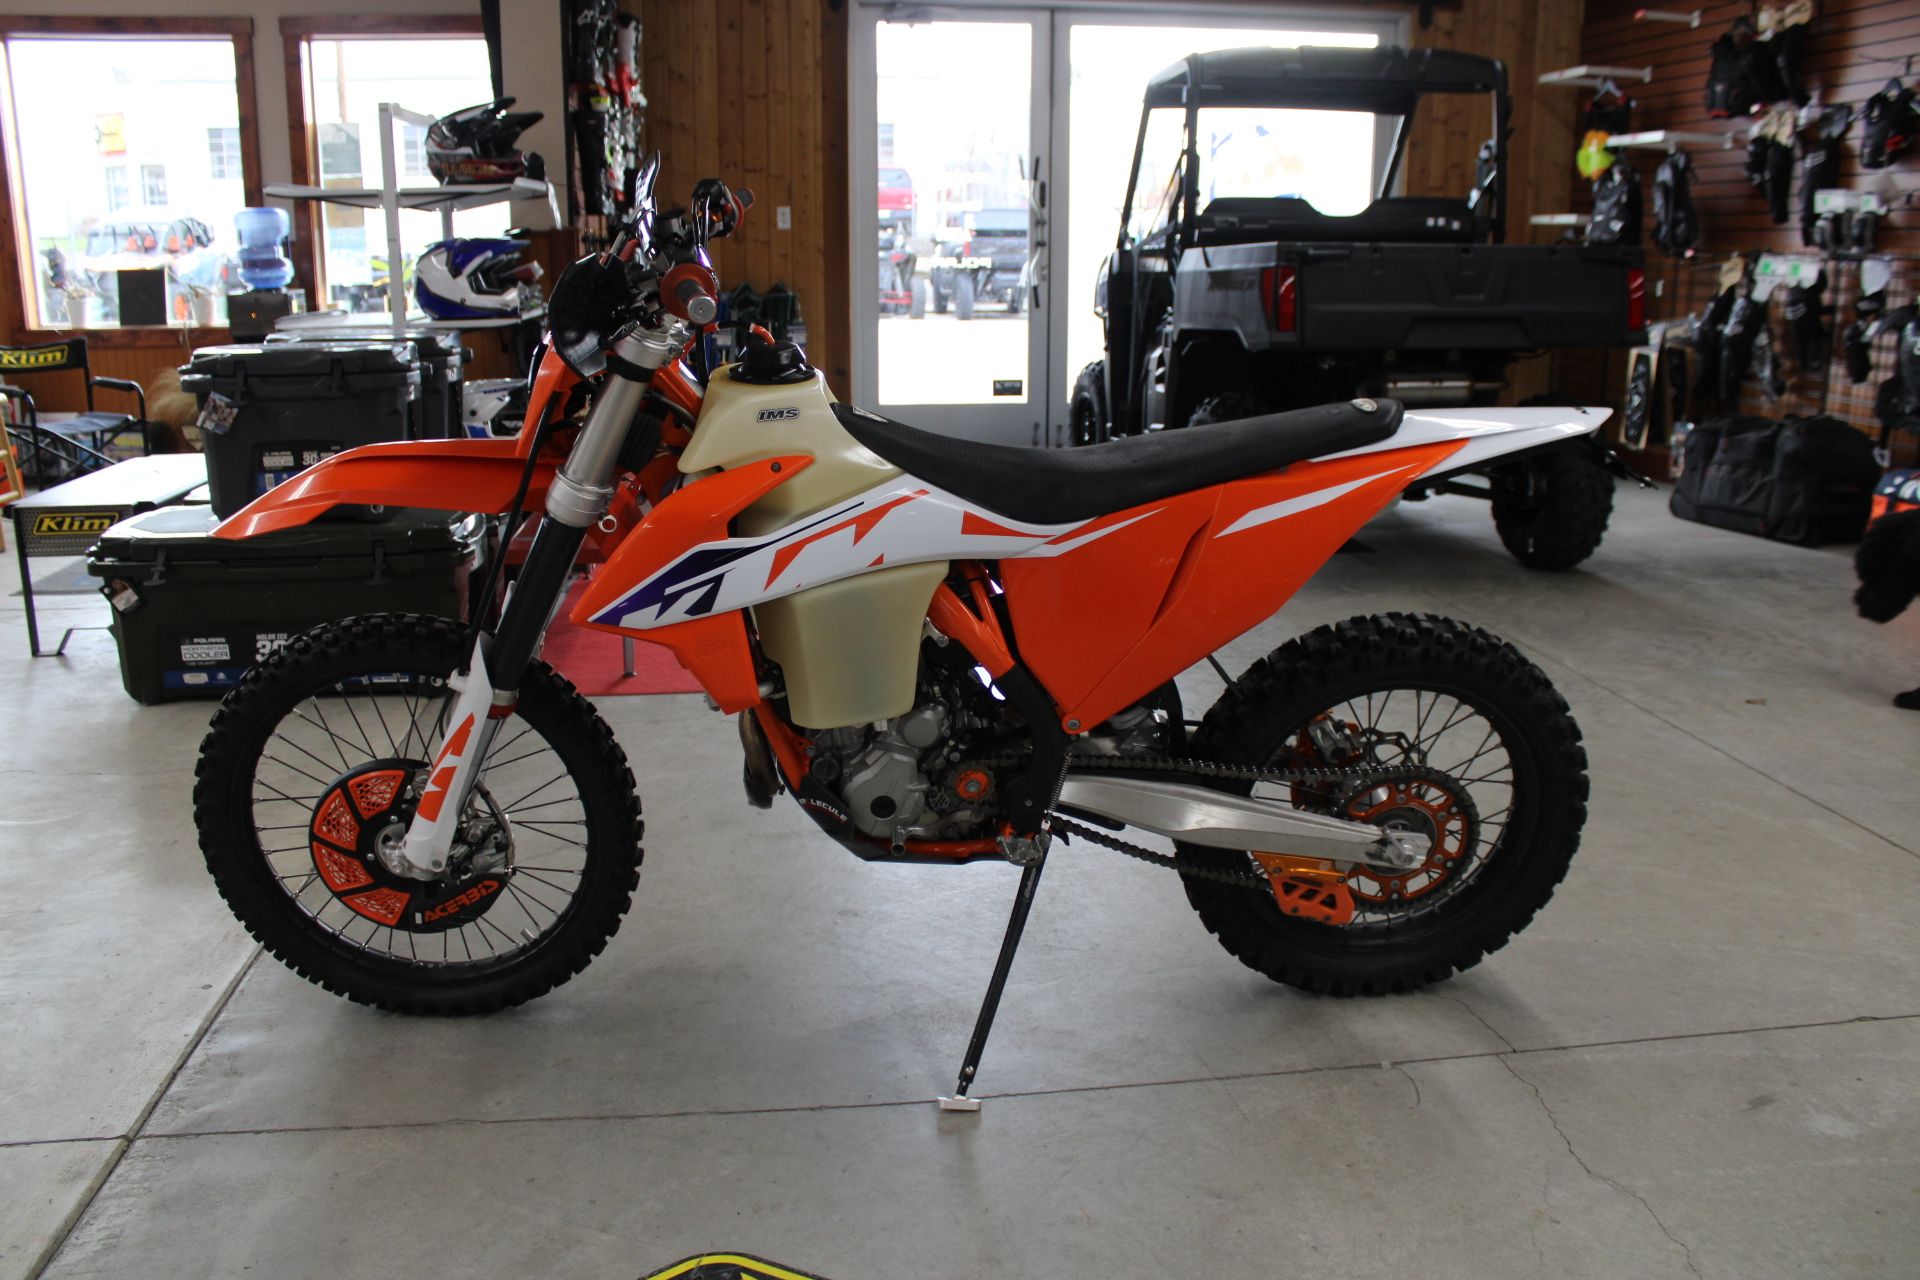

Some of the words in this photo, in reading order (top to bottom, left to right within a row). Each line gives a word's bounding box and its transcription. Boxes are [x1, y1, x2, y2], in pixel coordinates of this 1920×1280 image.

[757, 407, 800, 422] IMS
[40, 516, 112, 532] Klim
[184, 651, 229, 660] COOLER
